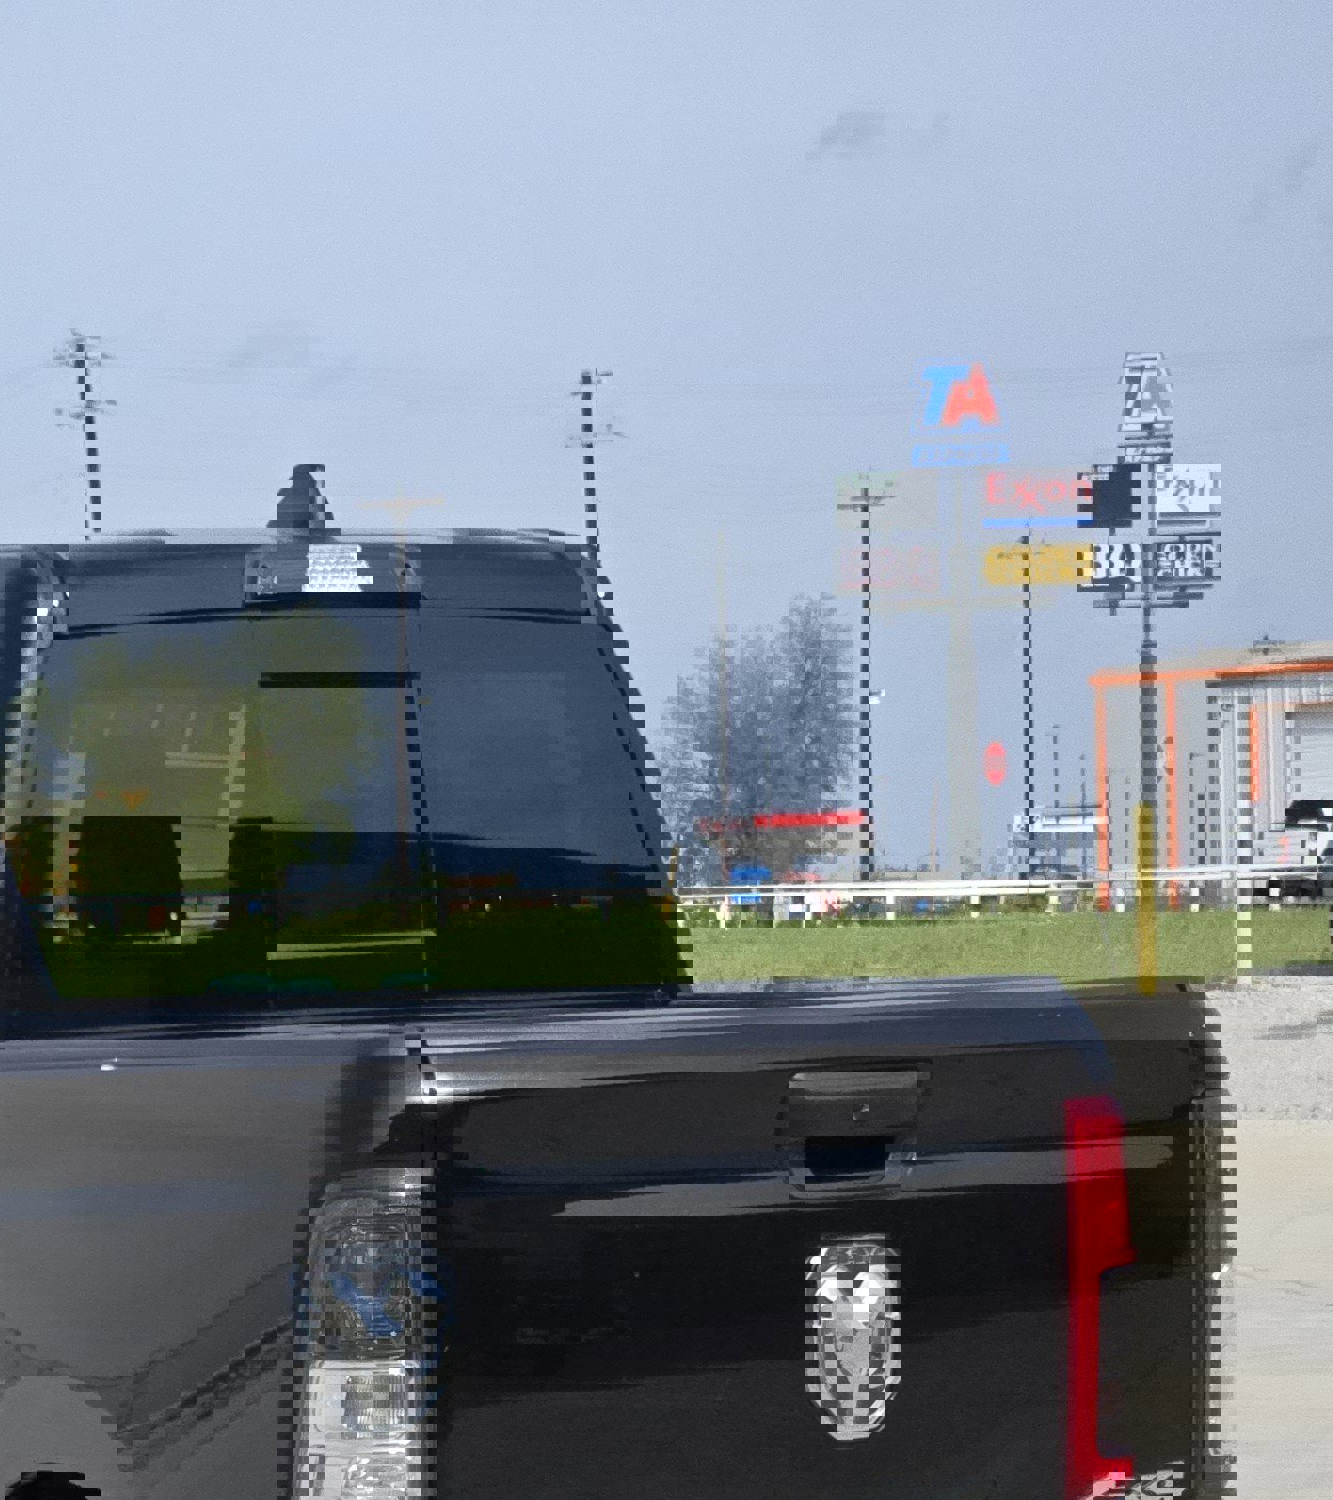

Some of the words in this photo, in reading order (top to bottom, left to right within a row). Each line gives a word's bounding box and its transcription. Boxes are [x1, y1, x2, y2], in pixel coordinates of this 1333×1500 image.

[920, 363, 1000, 426] TA
[916, 444, 1002, 465] EXPRESS
[986, 472, 1092, 514] Exxon
[986, 545, 1094, 568] GOLDEN
[841, 546, 938, 591] BBQ
[995, 566, 1076, 585] CHICK
[700, 818, 747, 834] Exon
[325, 1249, 424, 1269] RAM
